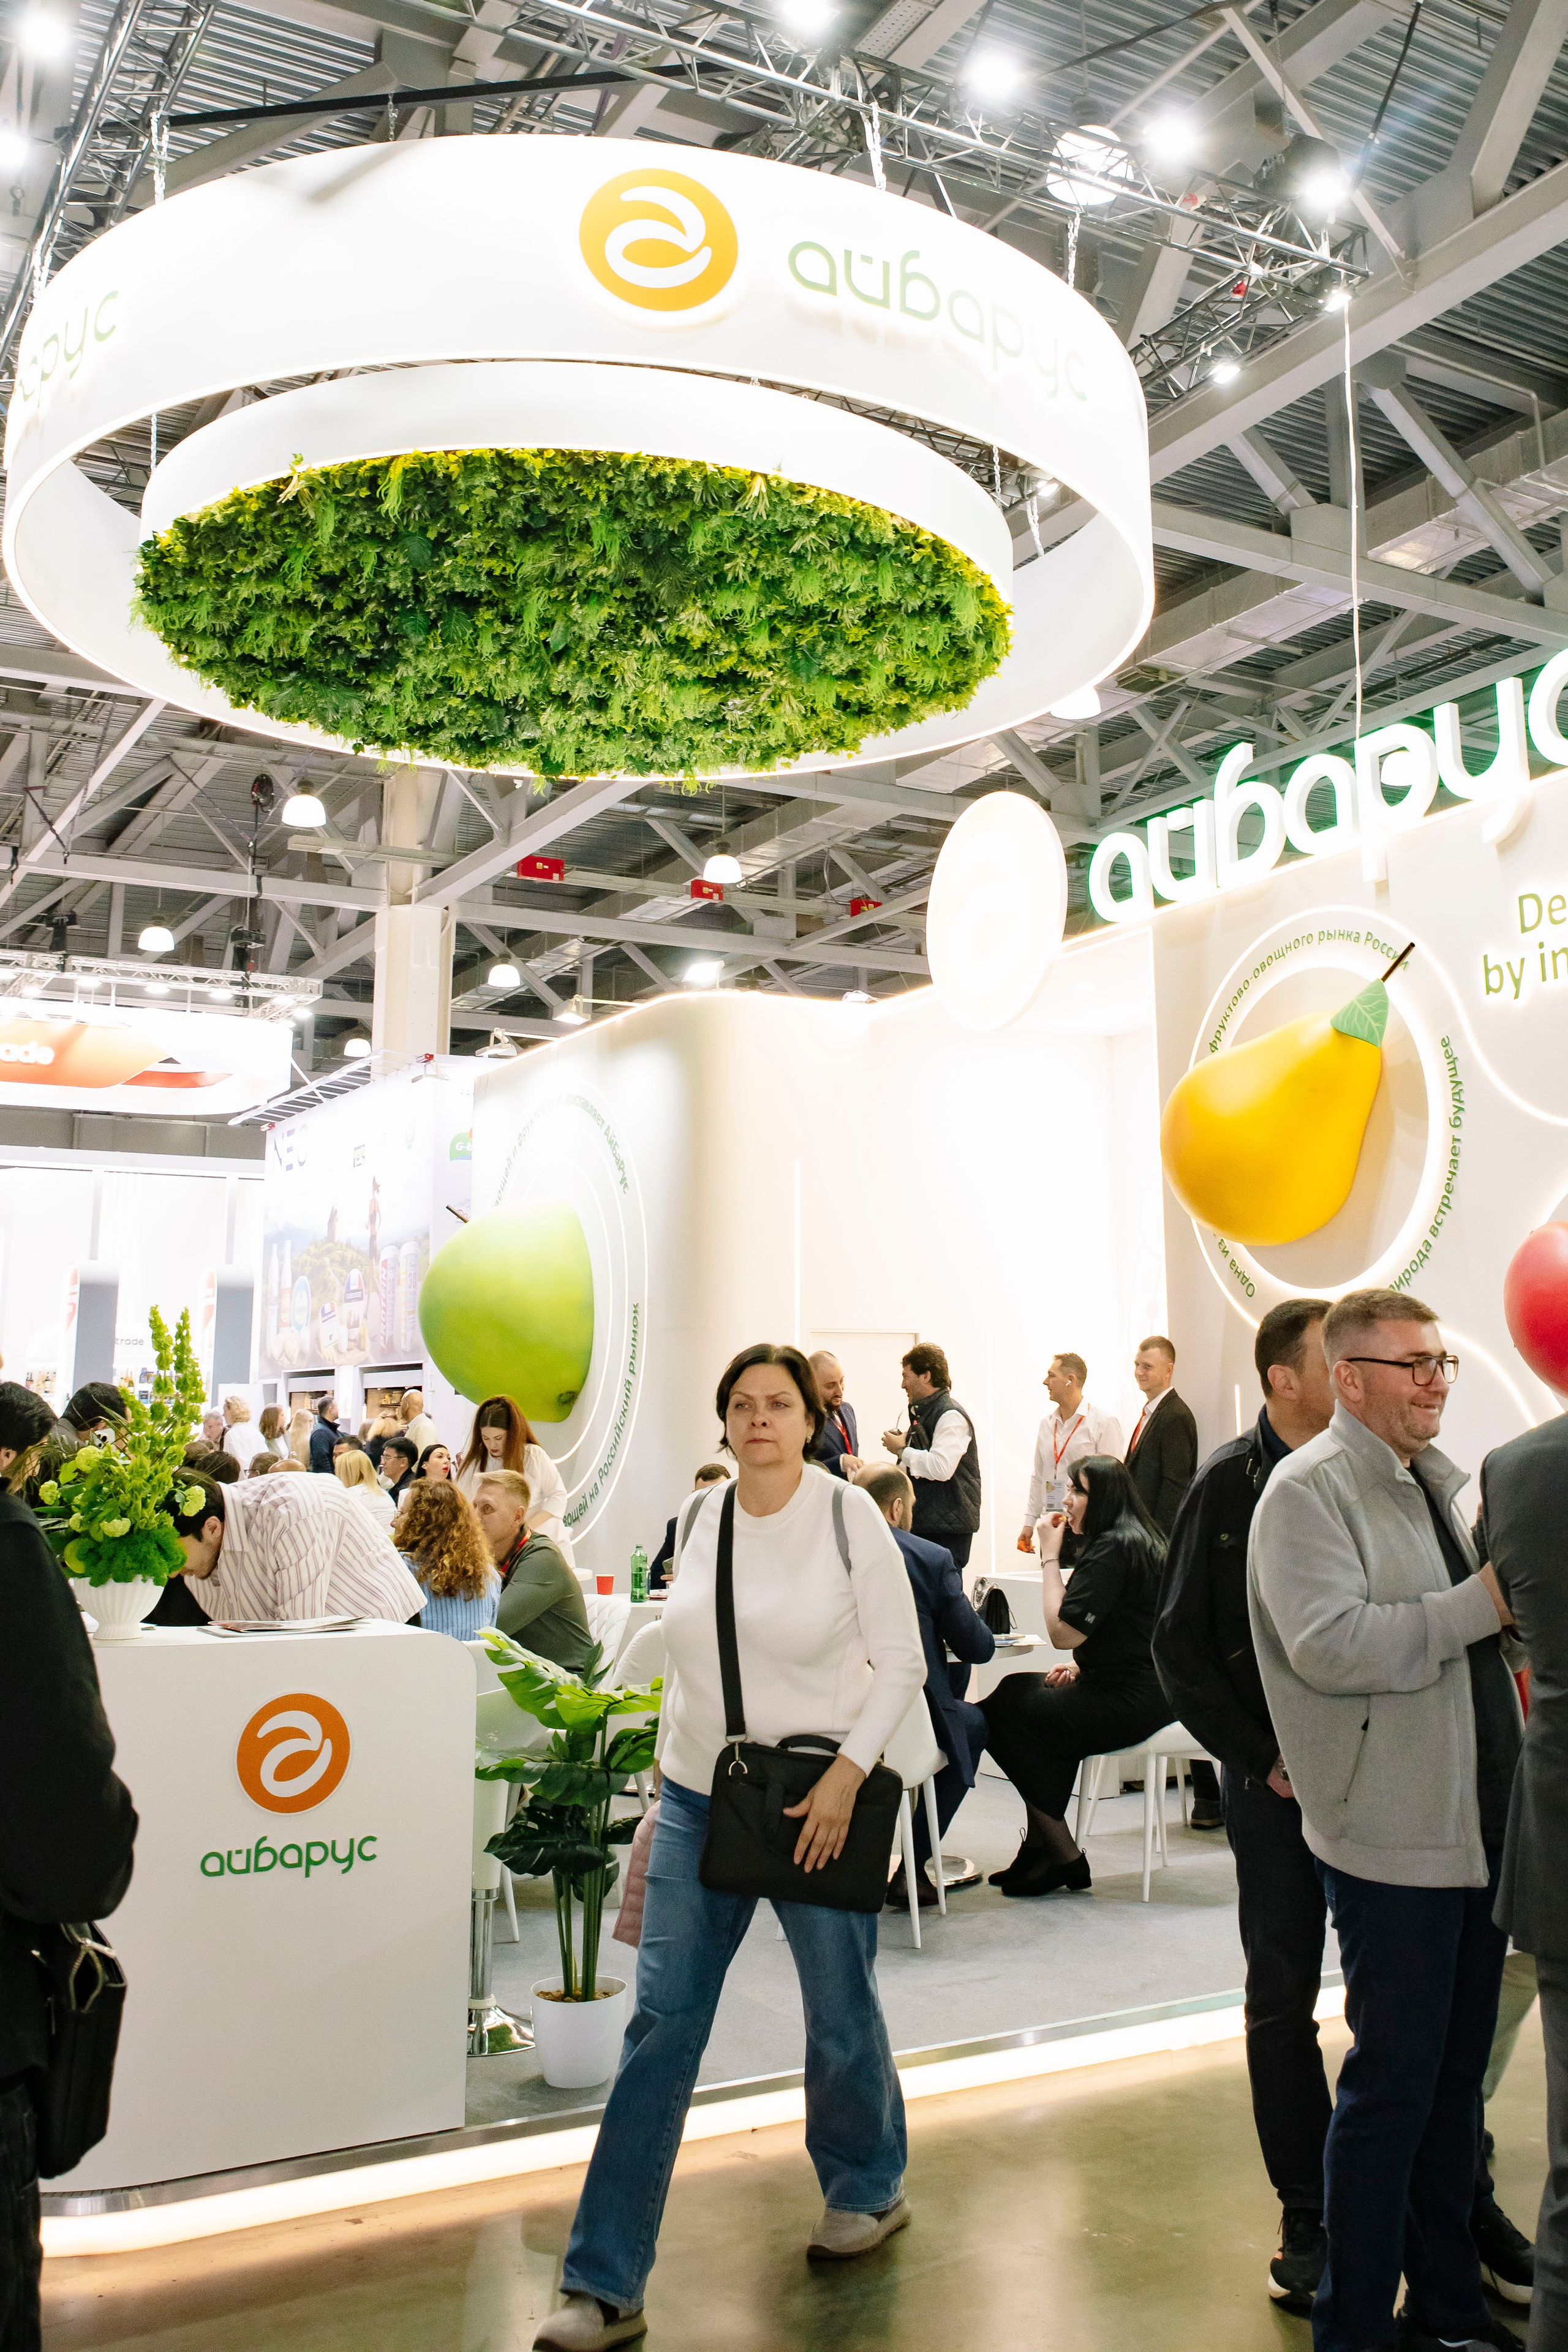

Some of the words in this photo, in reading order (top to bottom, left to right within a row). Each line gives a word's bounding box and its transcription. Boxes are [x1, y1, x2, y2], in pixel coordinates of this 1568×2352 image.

[20, 290, 119, 409] арус
[788, 241, 1087, 402] айбарус
[1518, 893, 1567, 934] De
[1209, 933, 1313, 1053] фруктово-овощного
[1318, 929, 1360, 945] рынка
[1483, 954, 1525, 1000] by
[1538, 941, 1568, 982] in
[1441, 1035, 1465, 1128] будущее
[494, 1156, 513, 1207] вощей
[1429, 1134, 1461, 1238] встречает
[1218, 1238, 1230, 1257] из
[1389, 1239, 1432, 1291] ирода
[1229, 1258, 1255, 1297] Одна
[562, 1492, 589, 1526] вощей
[589, 1482, 600, 1502] на
[598, 1378, 633, 1484] Российский
[628, 1302, 639, 1376] рынок
[200, 1835, 378, 1878] айбарус
